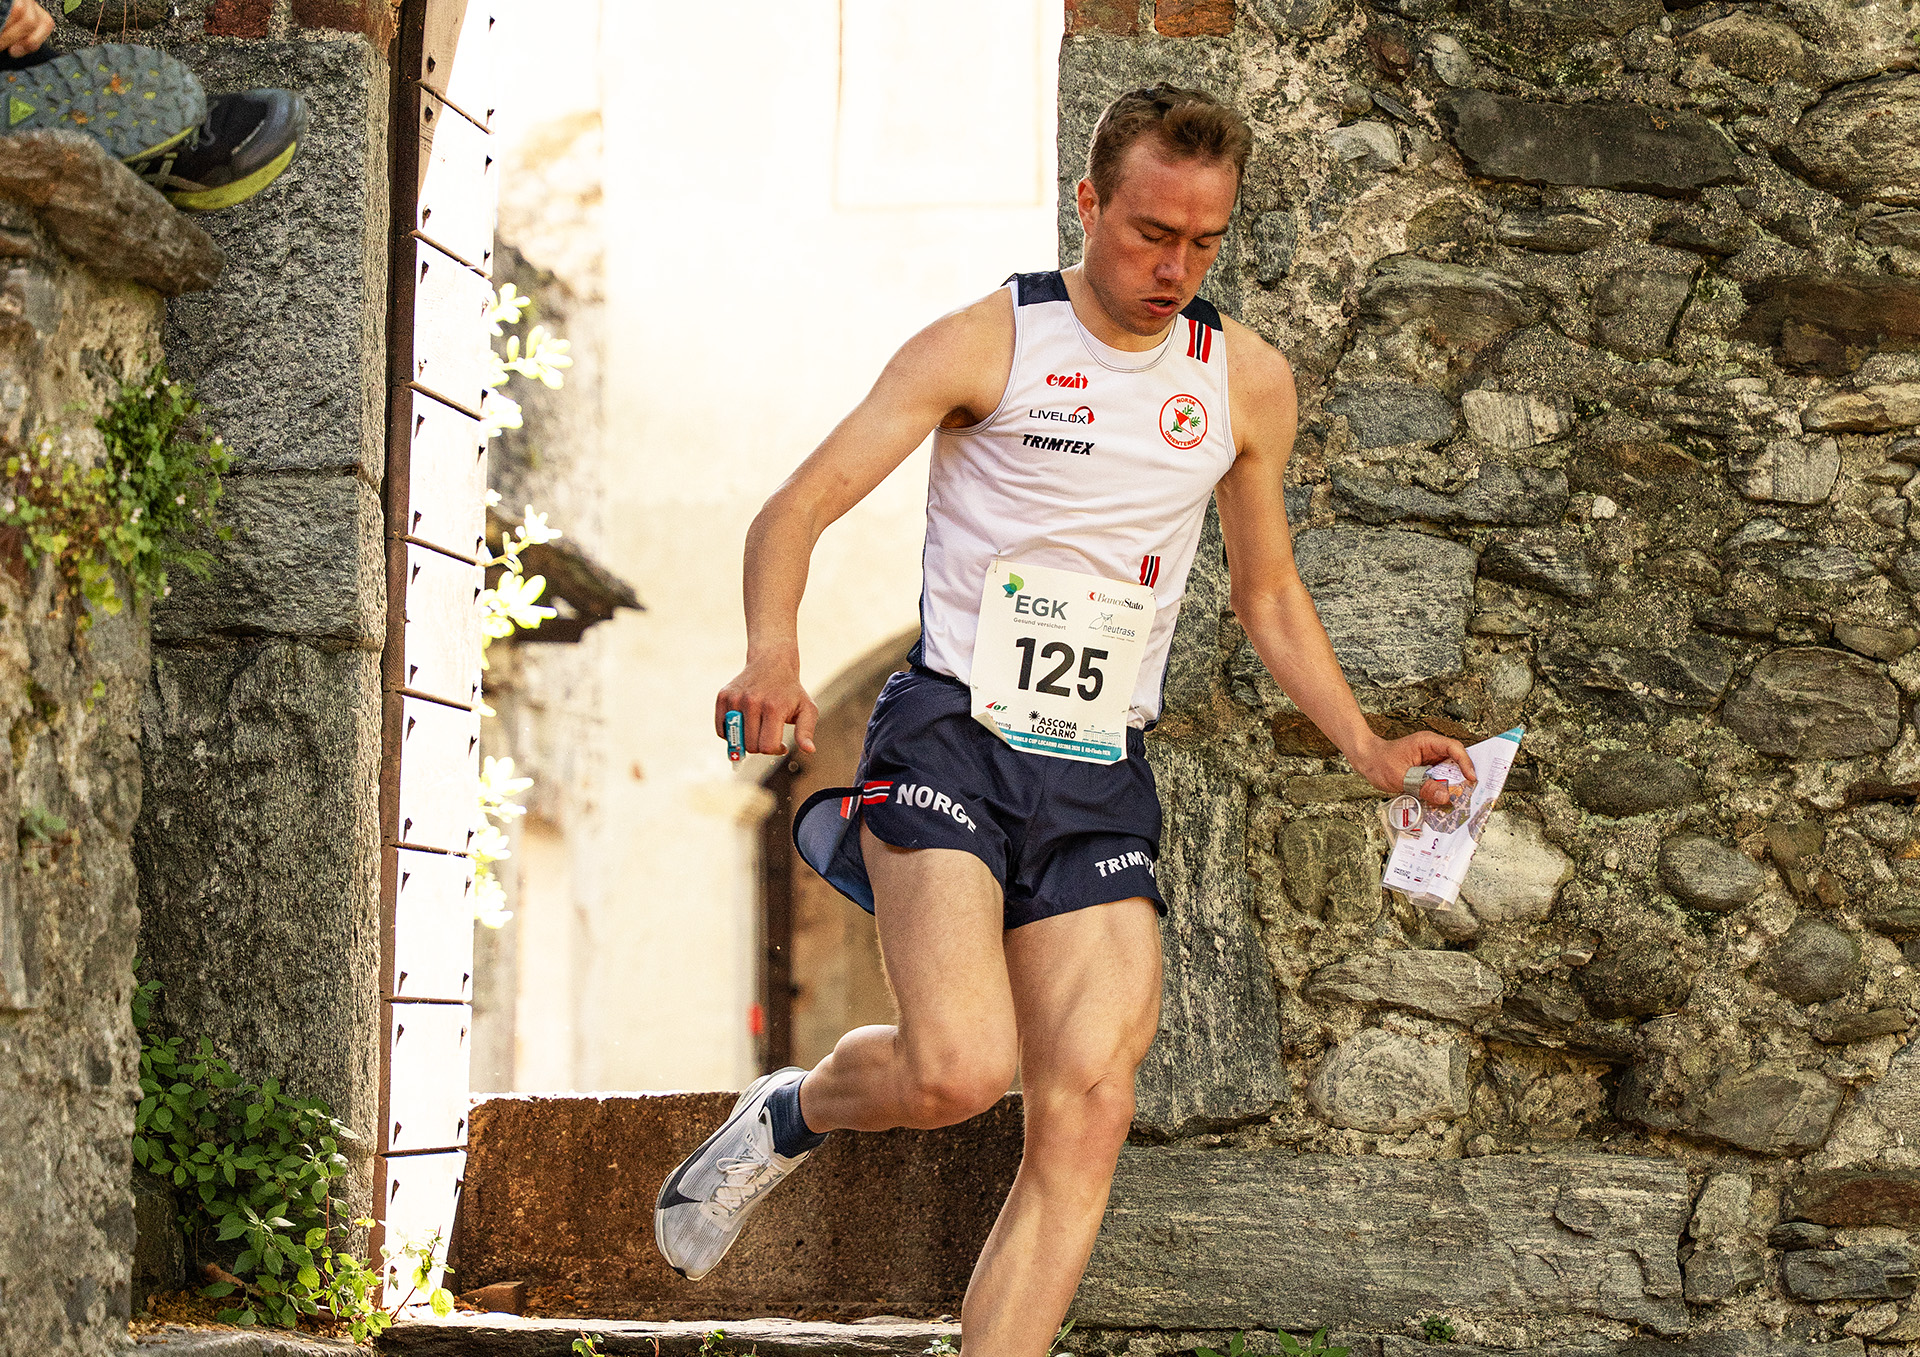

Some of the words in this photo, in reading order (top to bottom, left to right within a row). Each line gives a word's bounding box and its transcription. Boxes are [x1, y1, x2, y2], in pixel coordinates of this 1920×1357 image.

[1046, 372, 1089, 390] emit
[1176, 397, 1196, 407] NORSK
[1029, 409, 1087, 425] LIVELOX
[1022, 433, 1095, 456] TRIMTEX
[1164, 430, 1201, 447] ORIENTERING
[1014, 594, 1069, 621] EGK
[1097, 592, 1144, 612] BancoStato
[1013, 617, 1036, 627] Gesund
[1037, 621, 1067, 631] versichert
[1102, 623, 1136, 638] neutrass
[1015, 637, 1109, 702] 125
[1038, 717, 1077, 731] ASCONA
[1031, 725, 1076, 740] LOCARNO
